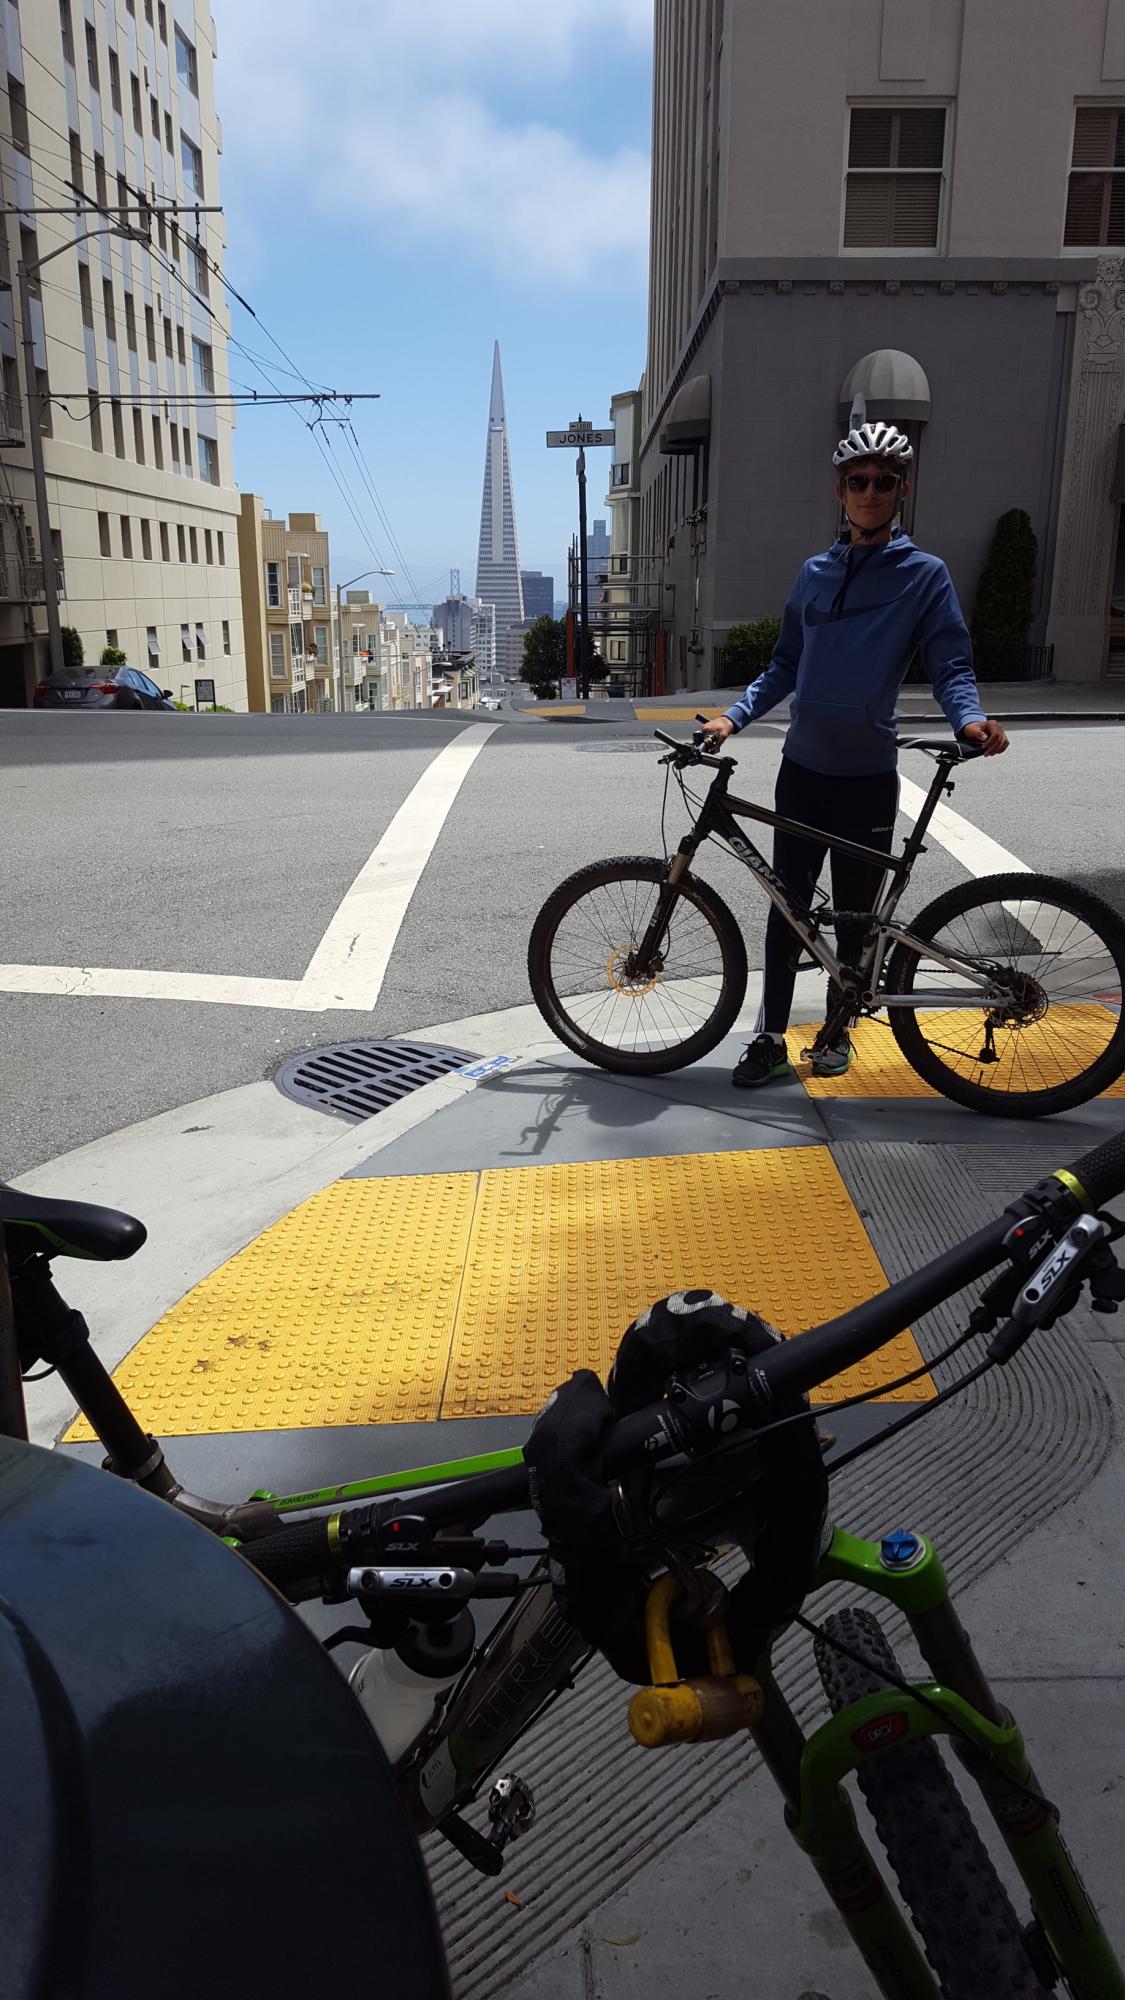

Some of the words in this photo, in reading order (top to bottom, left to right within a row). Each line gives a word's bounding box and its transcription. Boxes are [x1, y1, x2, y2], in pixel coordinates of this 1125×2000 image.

[560, 433, 603, 443] JONES
[728, 836, 786, 890] GIANT
[1028, 1227, 1053, 1260] SLX
[1041, 1250, 1071, 1290] SLX
[384, 1541, 420, 1551] SLX
[389, 1577, 435, 1588] SLX
